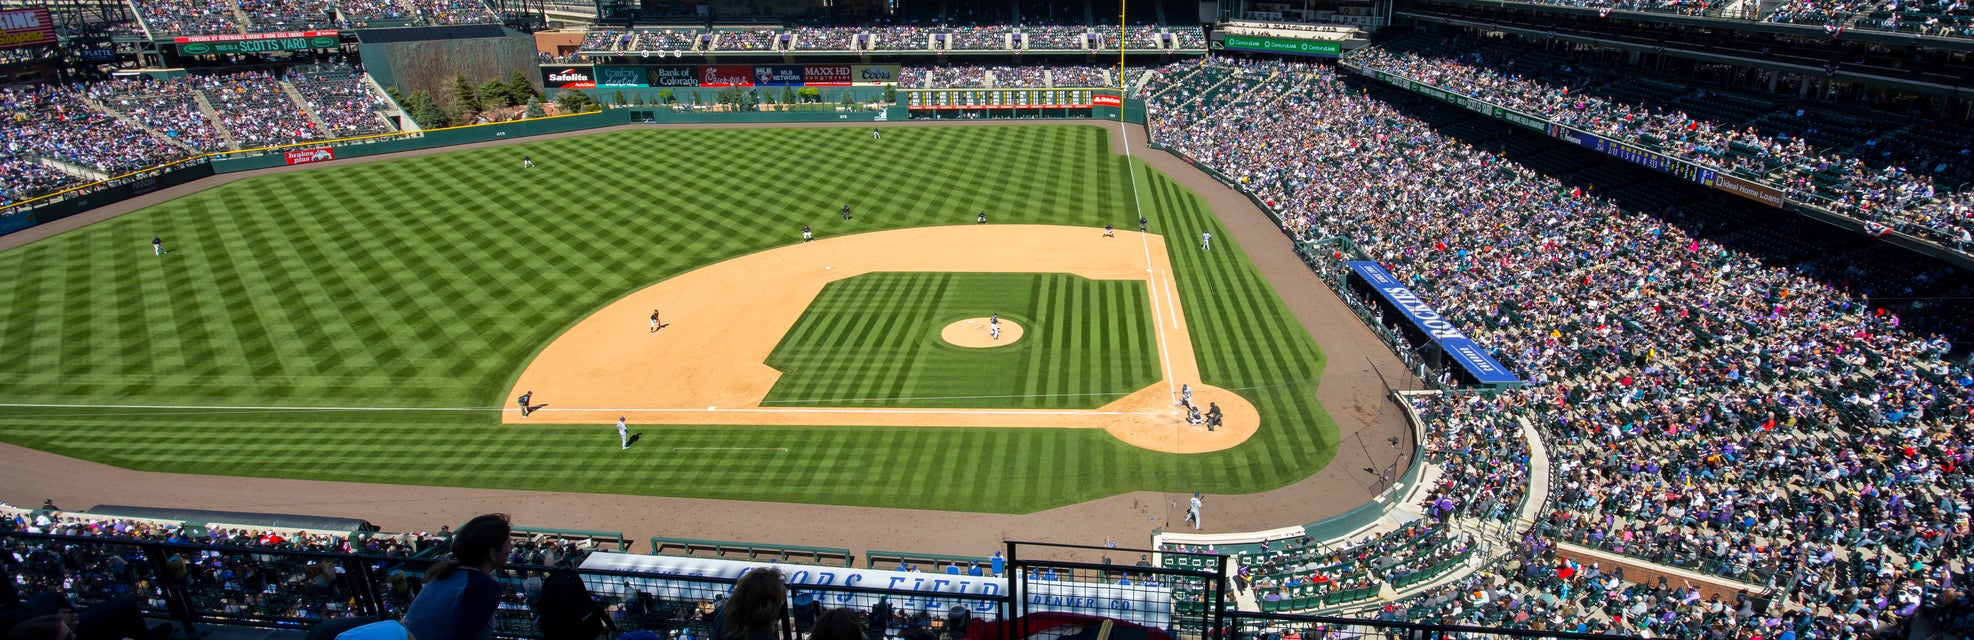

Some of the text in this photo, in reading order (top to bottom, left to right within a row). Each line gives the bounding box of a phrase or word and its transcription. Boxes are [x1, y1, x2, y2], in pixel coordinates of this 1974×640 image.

[240, 39, 279, 52] SCOTTS
[280, 38, 307, 50] YARD
[1309, 44, 1335, 52] CenturyLink
[658, 68, 690, 77] Bank of
[805, 67, 850, 75] MAXX HD
[861, 69, 891, 80] Coors
[549, 73, 588, 81] Safelite
[605, 74, 639, 86] dental
[660, 77, 699, 86] Colorado
[1723, 181, 1780, 204] Ideal Home Loans
[1384, 287, 1468, 340] ROCKIES
[728, 567, 999, 612] CORS FIELD
[1033, 595, 1095, 608] DENVER
